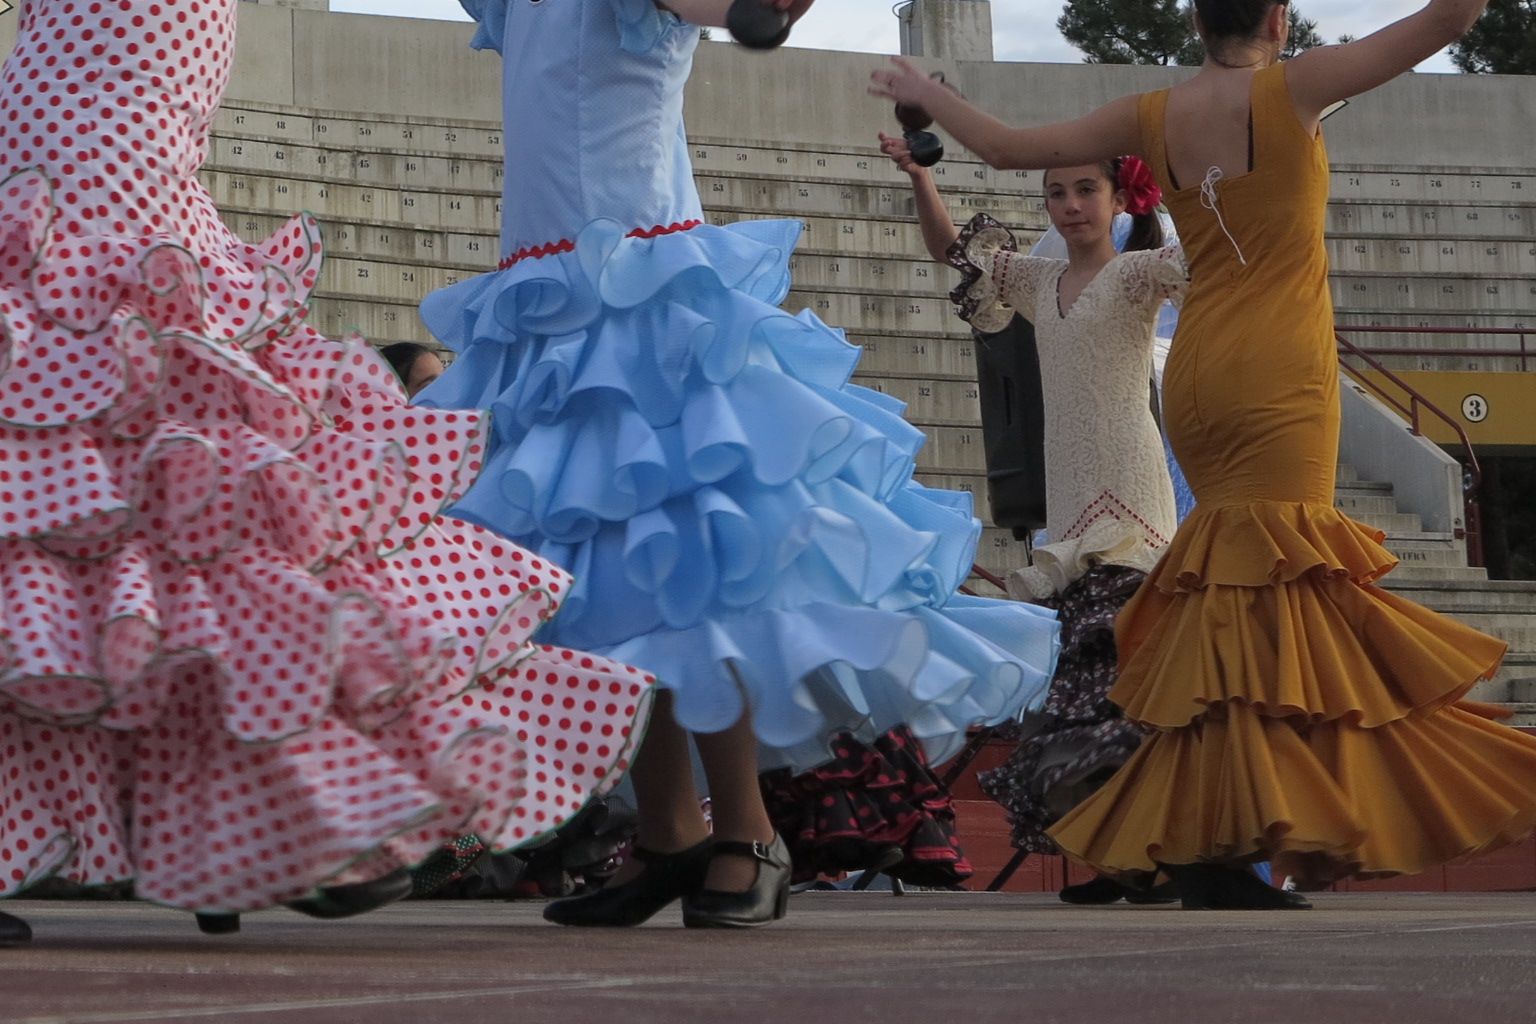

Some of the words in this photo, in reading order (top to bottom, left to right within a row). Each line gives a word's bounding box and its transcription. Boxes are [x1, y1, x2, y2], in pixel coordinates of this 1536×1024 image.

[234, 115, 245, 125] 47
[276, 121, 286, 130] 48
[316, 125, 327, 134] 49
[359, 128, 372, 137] 50
[402, 130, 414, 140] 51
[445, 133, 457, 142] 52
[488, 135, 500, 145] 53
[231, 145, 243, 156] 42
[696, 151, 707, 159] 58
[275, 150, 285, 161] 43
[737, 154, 747, 162] 59
[777, 156, 788, 164] 60
[358, 160, 370, 169] 45
[403, 162, 416, 172] 46
[817, 159, 826, 167] 61
[857, 162, 867, 170] 62
[935, 167, 945, 176] 64
[232, 180, 245, 191] 39
[1349, 178, 1360, 186] 74
[275, 185, 288, 195] 40
[713, 183, 724, 192] 53
[318, 189, 329, 199] 41
[798, 189, 809, 197] 55
[402, 198, 414, 207] 43
[882, 194, 892, 203] 57
[448, 200, 461, 210] 44
[1383, 211, 1394, 219] 66
[843, 225, 853, 234] 53
[884, 228, 896, 237] 54
[466, 241, 479, 251] 43
[1355, 245, 1366, 253] 62
[1443, 247, 1453, 255] 64
[358, 268, 369, 278] 23
[830, 264, 840, 273] 51
[916, 268, 927, 277] 53
[402, 272, 414, 282] 24
[1487, 286, 1498, 294] 63
[818, 300, 830, 309] 33
[909, 305, 920, 314] 35
[913, 345, 925, 355] 34
[960, 347, 971, 357] 35
[919, 387, 930, 396] 32
[1470, 400, 1481, 417] 3
